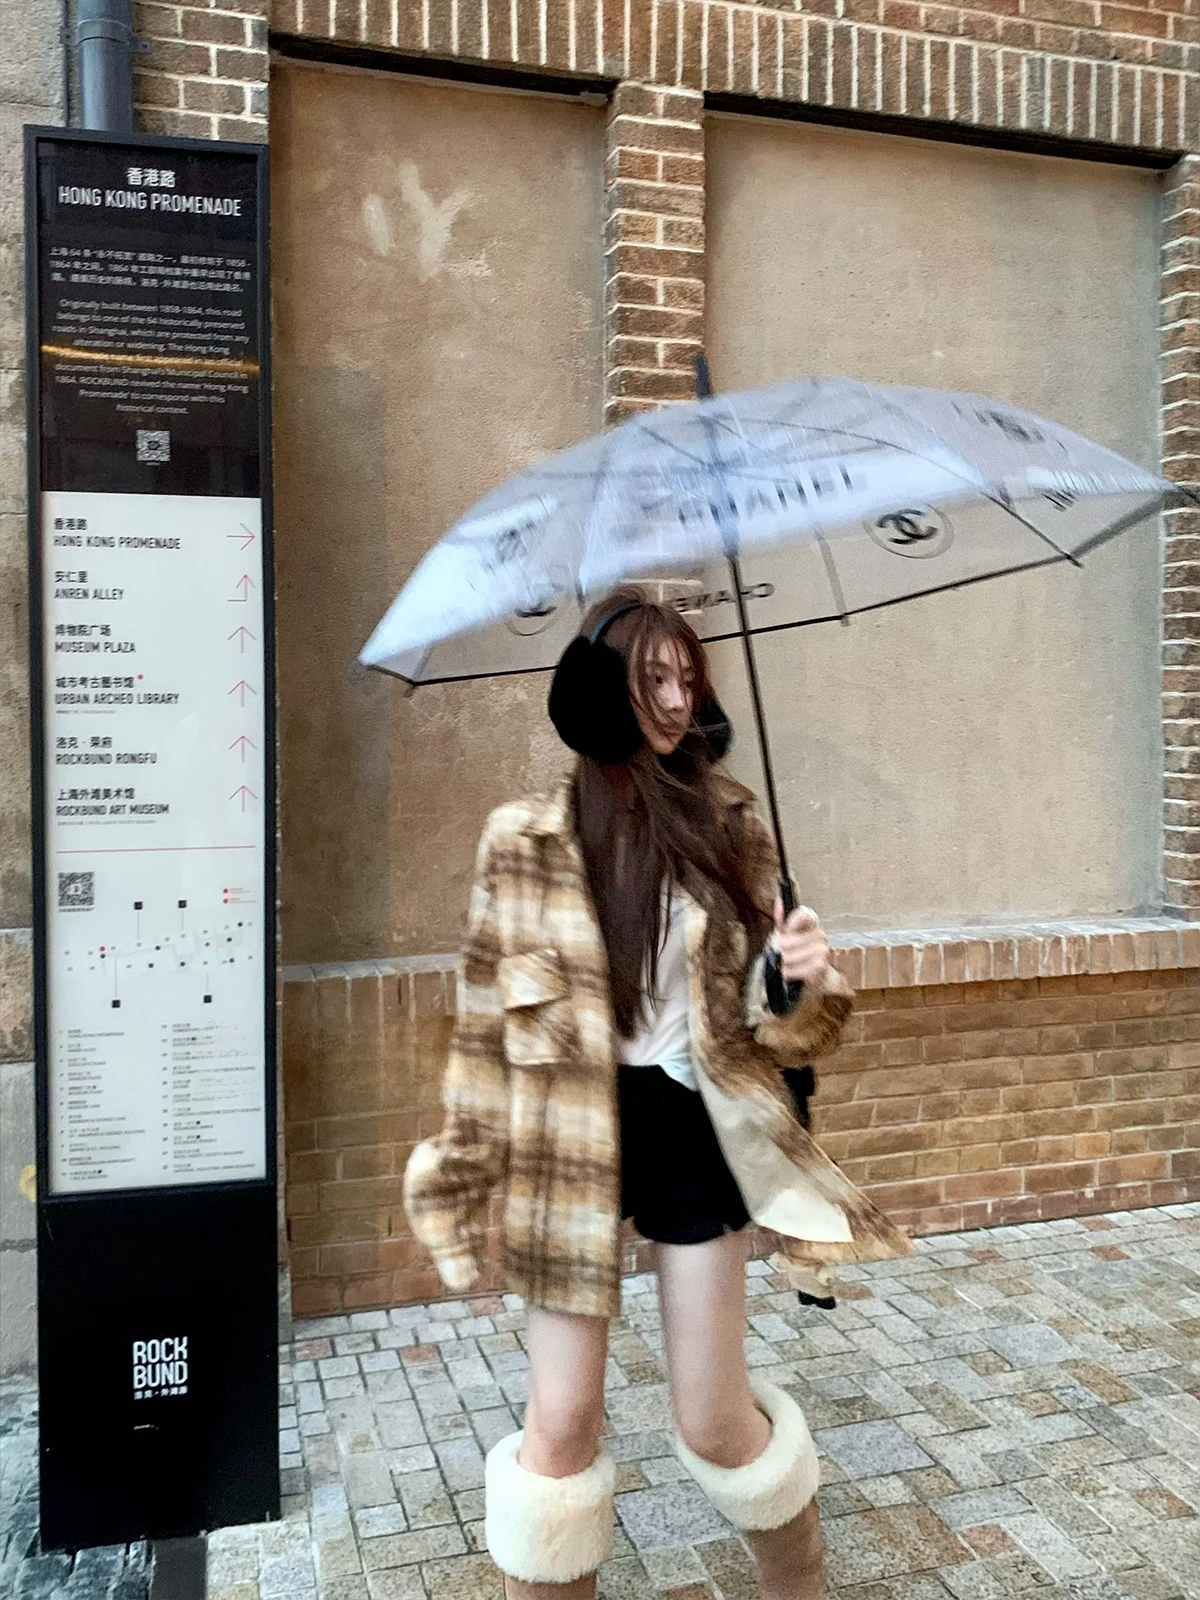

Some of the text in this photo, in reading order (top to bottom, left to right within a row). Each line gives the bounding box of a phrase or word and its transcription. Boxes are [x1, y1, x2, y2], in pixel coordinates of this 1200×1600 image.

[126, 167, 176, 188] 香港路
[58, 186, 242, 216] HONG KONG PROMENADE
[54, 517, 87, 530] 香港路
[54, 535, 181, 550] HONG KONG PROMENADE
[55, 571, 88, 583] 安仁里
[54, 588, 124, 600] ANREN ALLEY
[55, 624, 111, 637] 博物院广场
[55, 641, 136, 653] MUSEUM PLAZA
[55, 693, 180, 705] URBAN ARCHEO LIBRARY
[56, 753, 157, 765] ROCKBUND RONGFU
[57, 788, 135, 801] 上海外滩美术馆
[56, 804, 169, 817] ROCKBUND ART MUSEUM
[133, 1336, 188, 1365] ROCK
[133, 1361, 188, 1390] BUND
